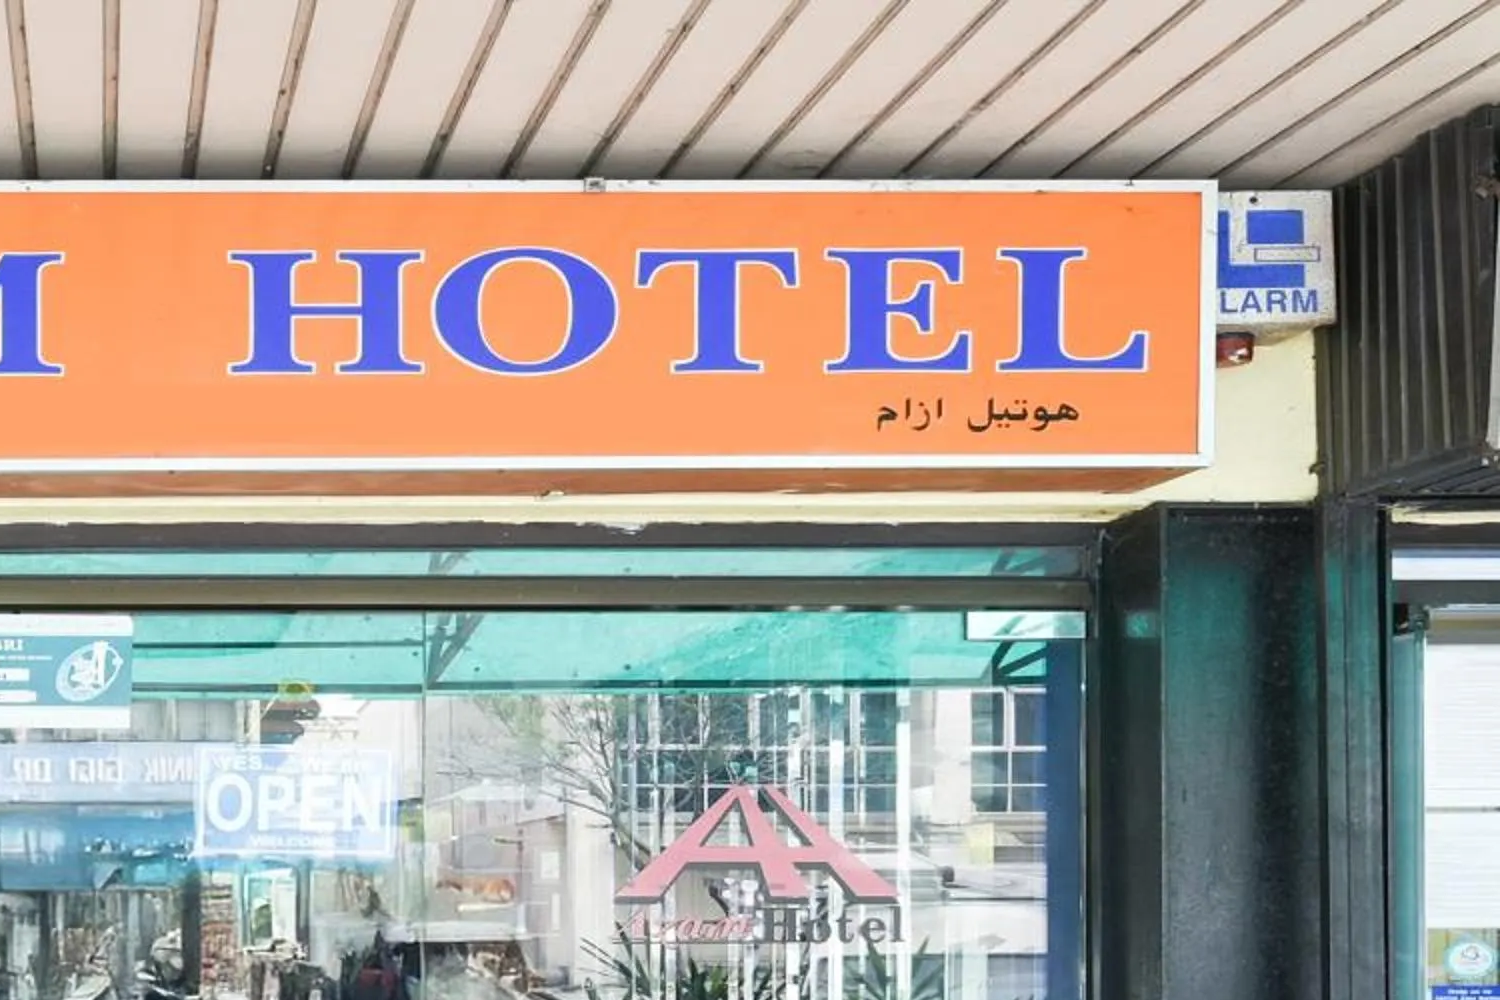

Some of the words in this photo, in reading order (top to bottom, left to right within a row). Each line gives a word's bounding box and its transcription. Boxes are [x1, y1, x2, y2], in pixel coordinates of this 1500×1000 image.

[229, 247, 1148, 375] HOTEL
[1220, 289, 1318, 313] LARM
[967, 397, 1080, 433] هوتيل
[206, 773, 382, 832] OPEN
[758, 907, 905, 943] Hotel
